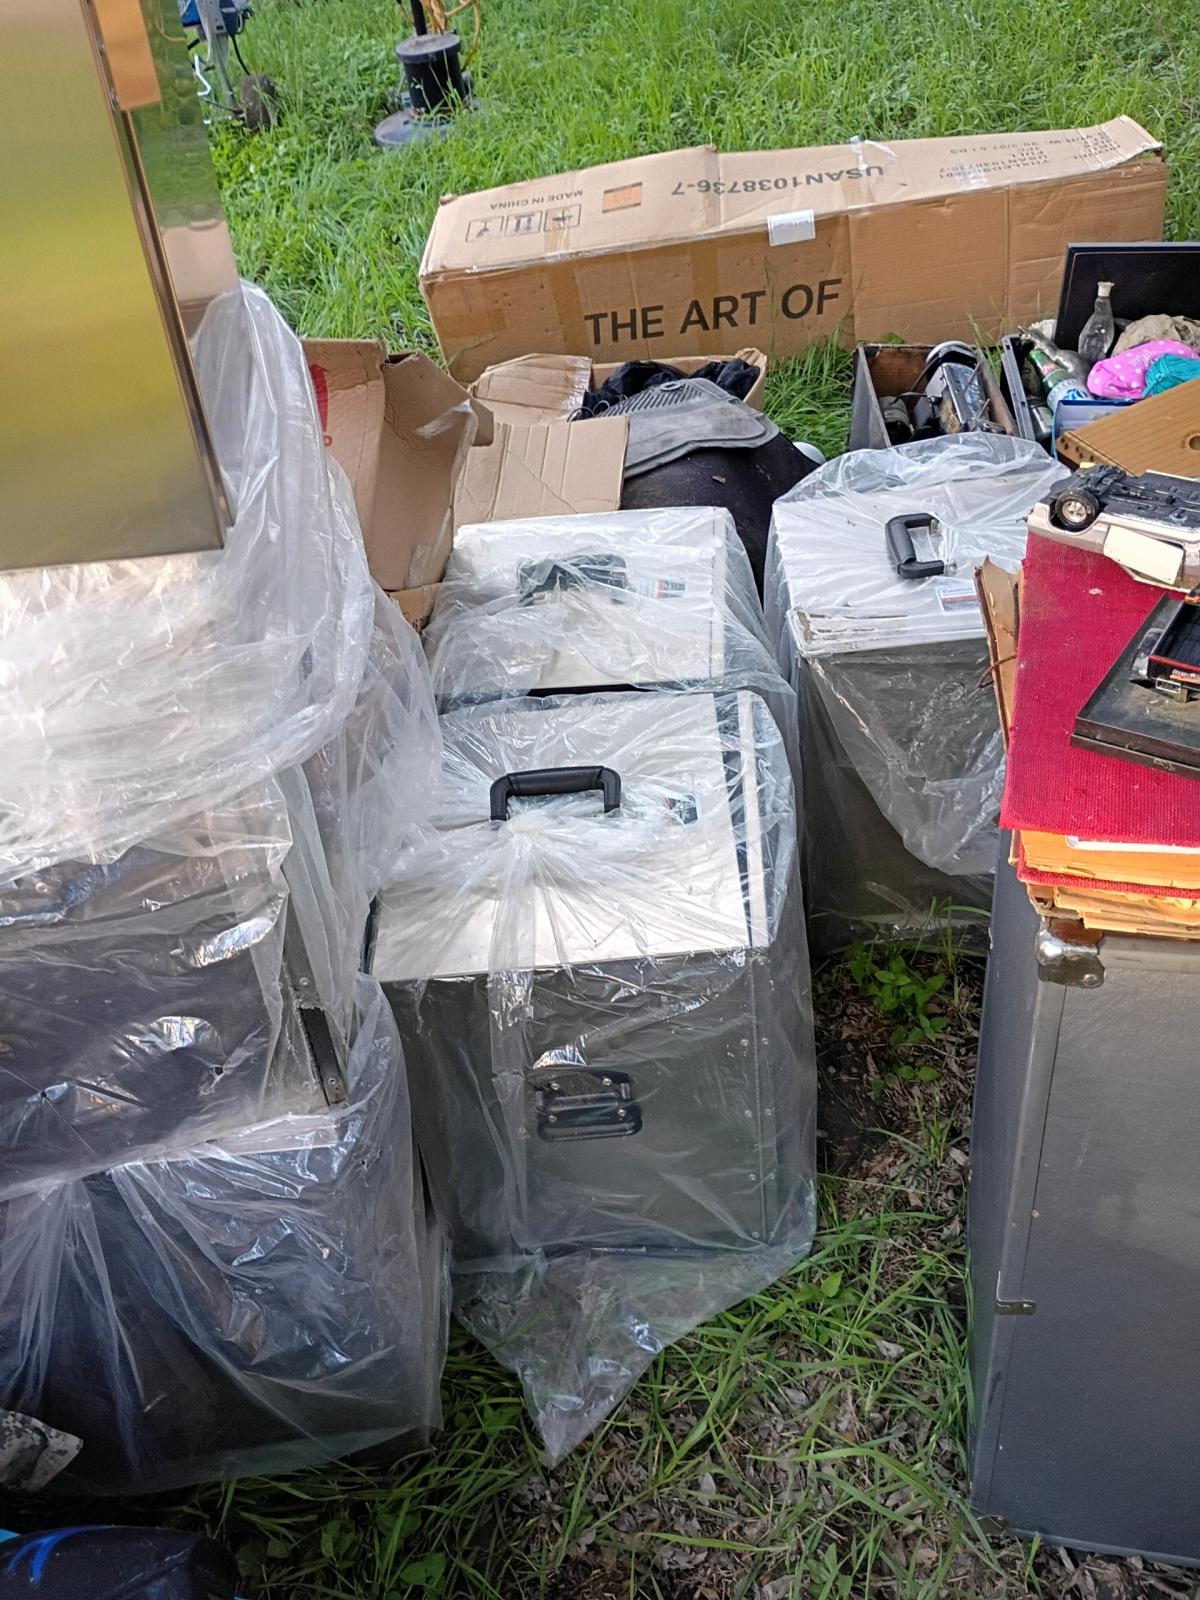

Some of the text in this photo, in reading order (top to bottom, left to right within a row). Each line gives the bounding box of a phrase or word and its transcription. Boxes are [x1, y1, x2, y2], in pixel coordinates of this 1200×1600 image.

[671, 166, 885, 195] USAN1038736-7
[490, 190, 583, 211] MADE IN CHINA
[584, 278, 842, 345] THE ART OF
